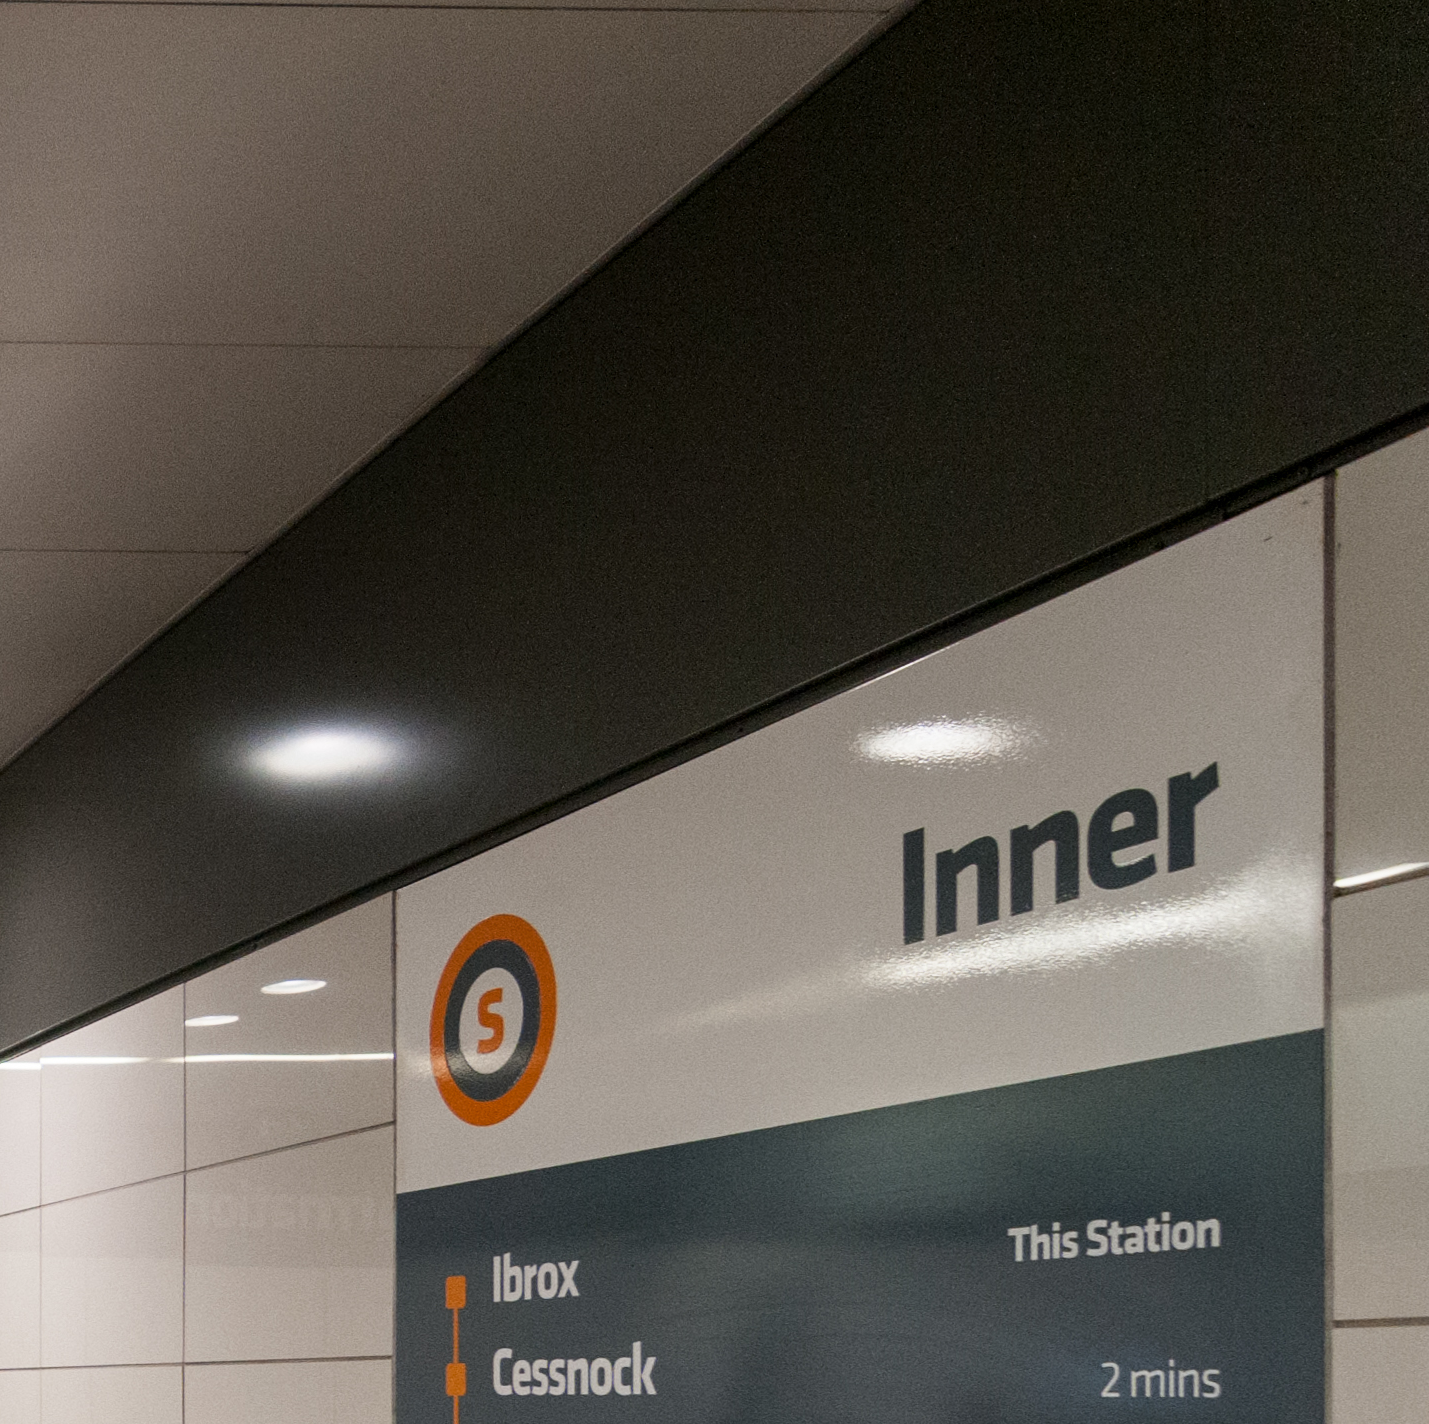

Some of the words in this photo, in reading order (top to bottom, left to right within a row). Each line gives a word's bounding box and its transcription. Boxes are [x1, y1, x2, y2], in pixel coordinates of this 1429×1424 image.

[902, 761, 1220, 946] Inner
[1007, 1221, 1079, 1262] This
[1086, 1212, 1222, 1257] Station
[493, 1252, 580, 1302] Ibrox
[493, 1340, 657, 1395] Cessnock
[1100, 1362, 1121, 1398] 2
[1130, 1359, 1222, 1398] mins
